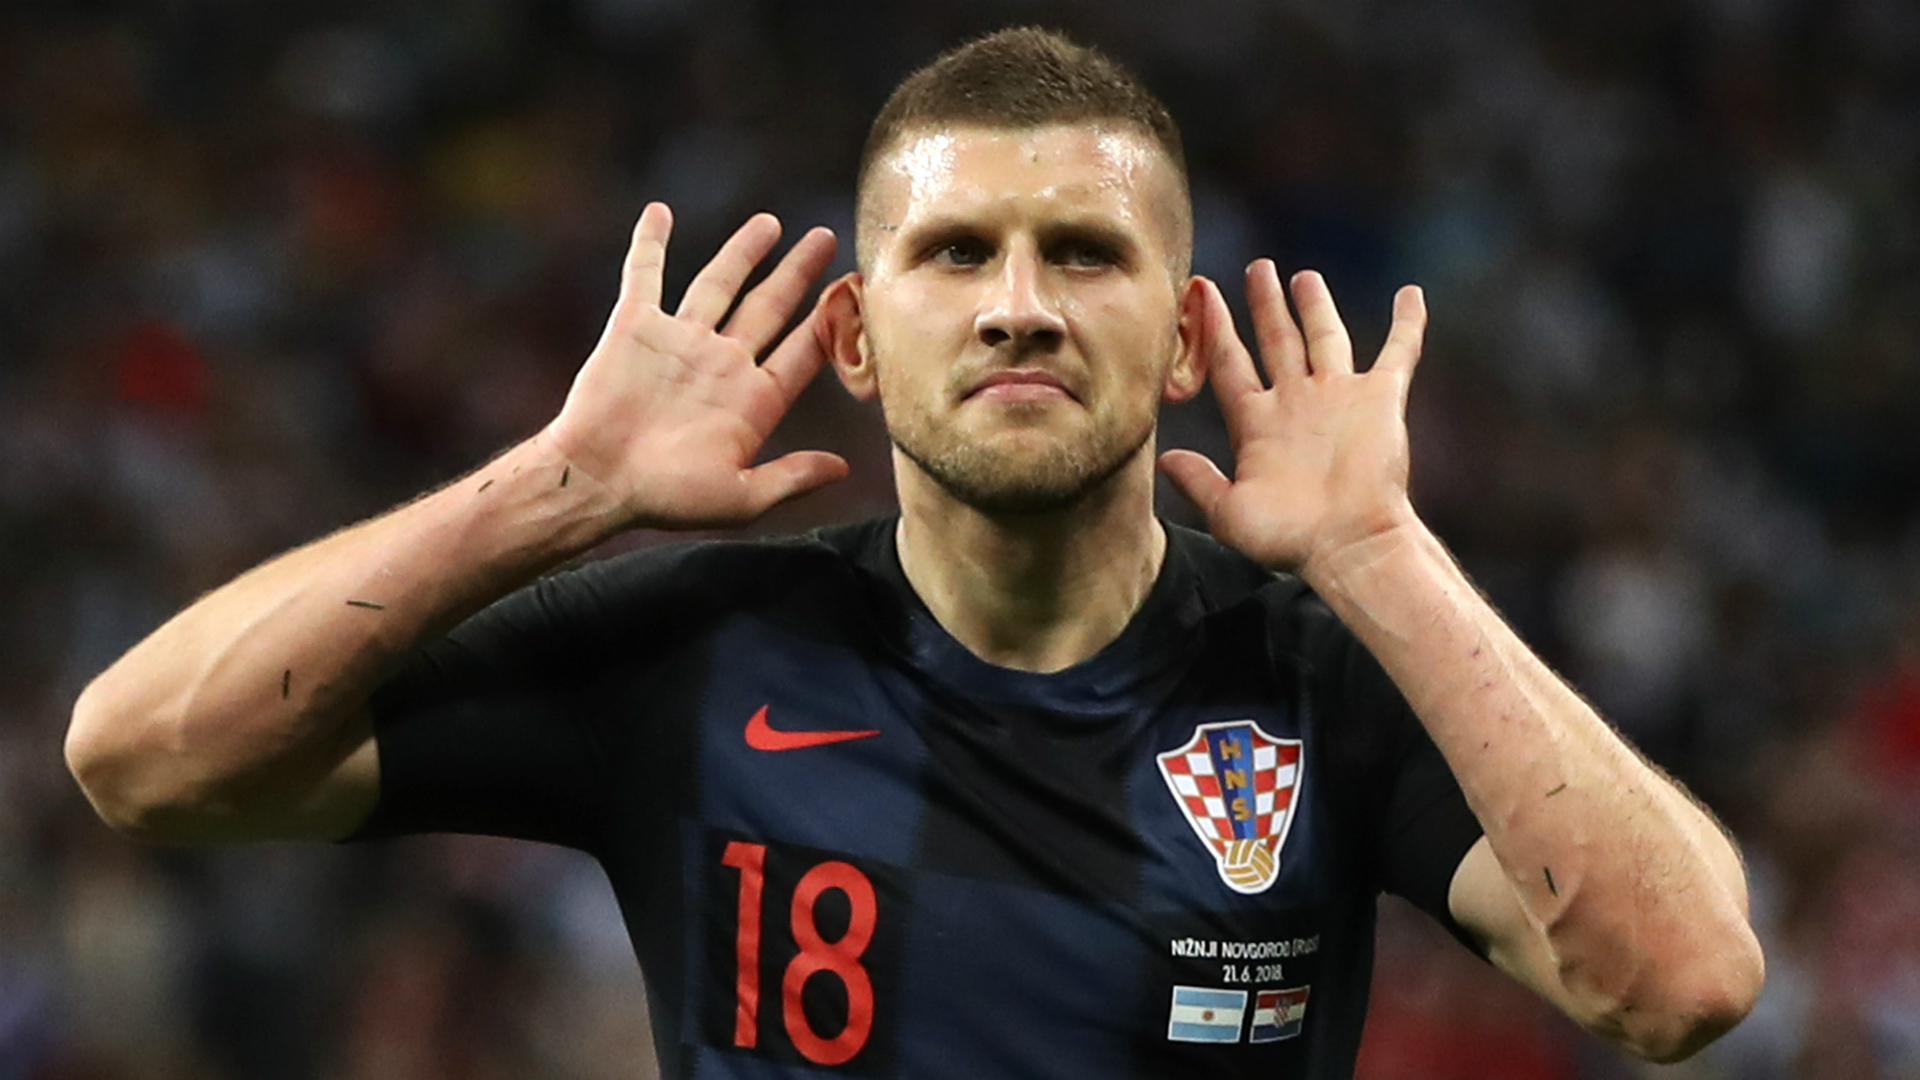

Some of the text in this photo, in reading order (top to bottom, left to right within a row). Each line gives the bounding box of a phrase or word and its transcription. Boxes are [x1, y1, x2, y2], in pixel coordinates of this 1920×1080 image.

[1219, 739, 1250, 821] HNS
[721, 841, 877, 1065] 18
[1170, 936, 1218, 957] NIŽNJI
[1221, 940, 1290, 960] NOVGOROD
